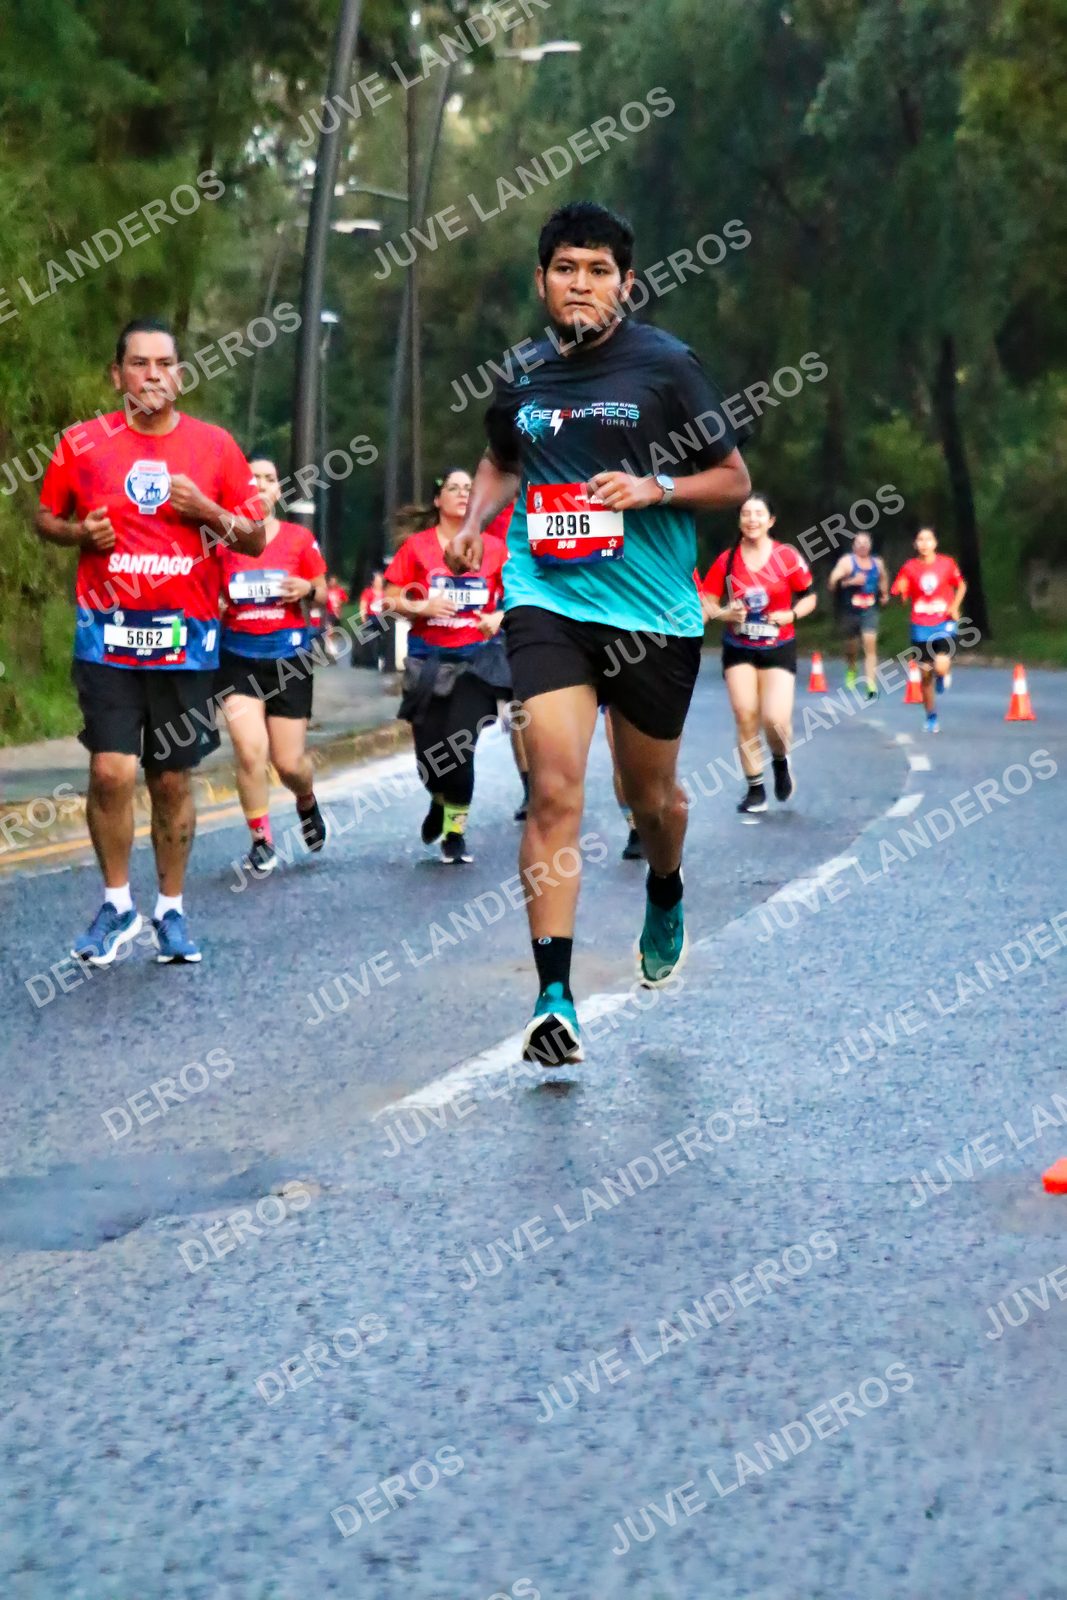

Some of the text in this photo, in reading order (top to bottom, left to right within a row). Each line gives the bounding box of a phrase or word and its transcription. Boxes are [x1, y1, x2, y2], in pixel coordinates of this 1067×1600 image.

[546, 513, 590, 536] 2896
[108, 553, 194, 575] SANTIAGO
[127, 630, 163, 646] 5662
